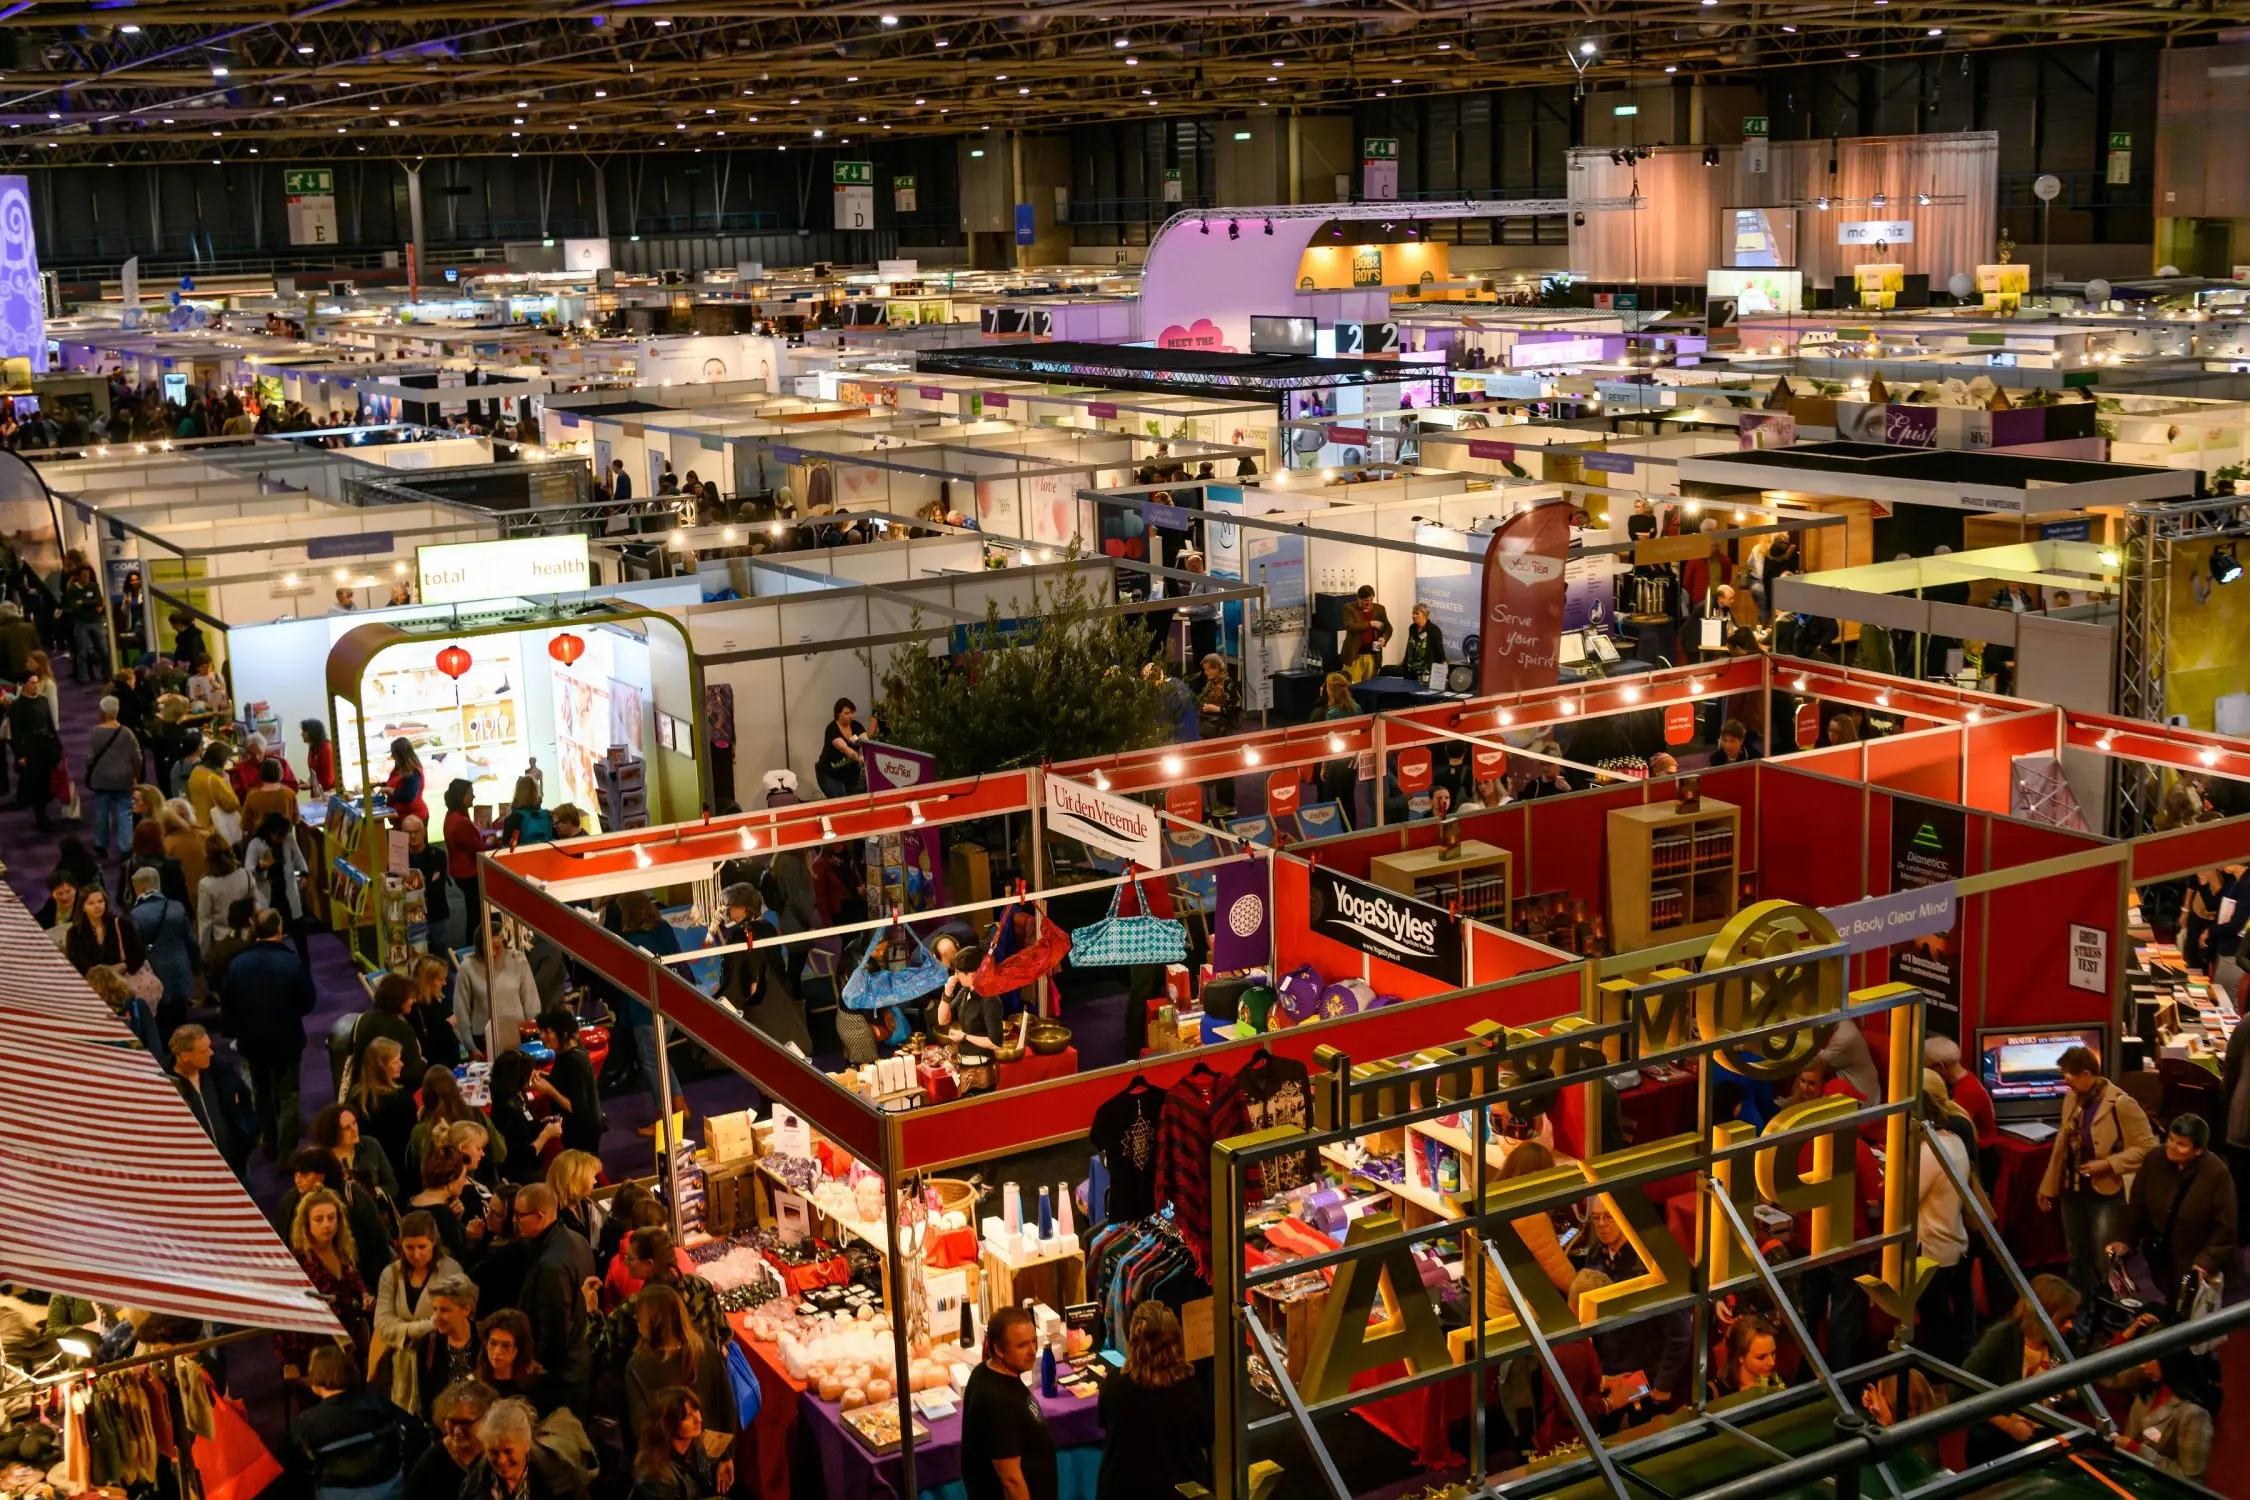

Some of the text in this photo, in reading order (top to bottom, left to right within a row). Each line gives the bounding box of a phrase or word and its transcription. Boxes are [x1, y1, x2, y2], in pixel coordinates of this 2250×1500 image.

[1381, 183, 1389, 199] C
[854, 212, 864, 228] D
[315, 225, 325, 242] E
[1354, 269, 1381, 283] ROY'S
[849, 303, 858, 324] 7
[874, 304, 886, 325] 7
[990, 309, 998, 333] 7
[1014, 308, 1029, 333] 7
[1042, 311, 1052, 336] 2
[1723, 300, 1738, 328] 2
[1167, 336, 1214, 348] MEET THE
[1348, 325, 1362, 353] 2
[1381, 323, 1398, 353] 2
[1886, 413, 1936, 447] Epis
[1040, 475, 1057, 494] love
[112, 561, 141, 572] COAC
[424, 558, 586, 587] total health
[1490, 604, 1533, 627] Serve
[1498, 630, 1540, 656] your
[1517, 652, 1557, 669] spirit
[1053, 784, 1073, 811] Uit
[1074, 792, 1097, 821] den
[1094, 799, 1148, 839] Vreemde
[1907, 851, 1949, 871] Dianetics:
[1332, 880, 1435, 946] YogaStyles
[1853, 914, 1885, 936] Body
[1888, 907, 1917, 925] Clear
[1919, 897, 1948, 918] Mind
[2074, 945, 2102, 960] STRESS
[2077, 957, 2099, 974] TEST
